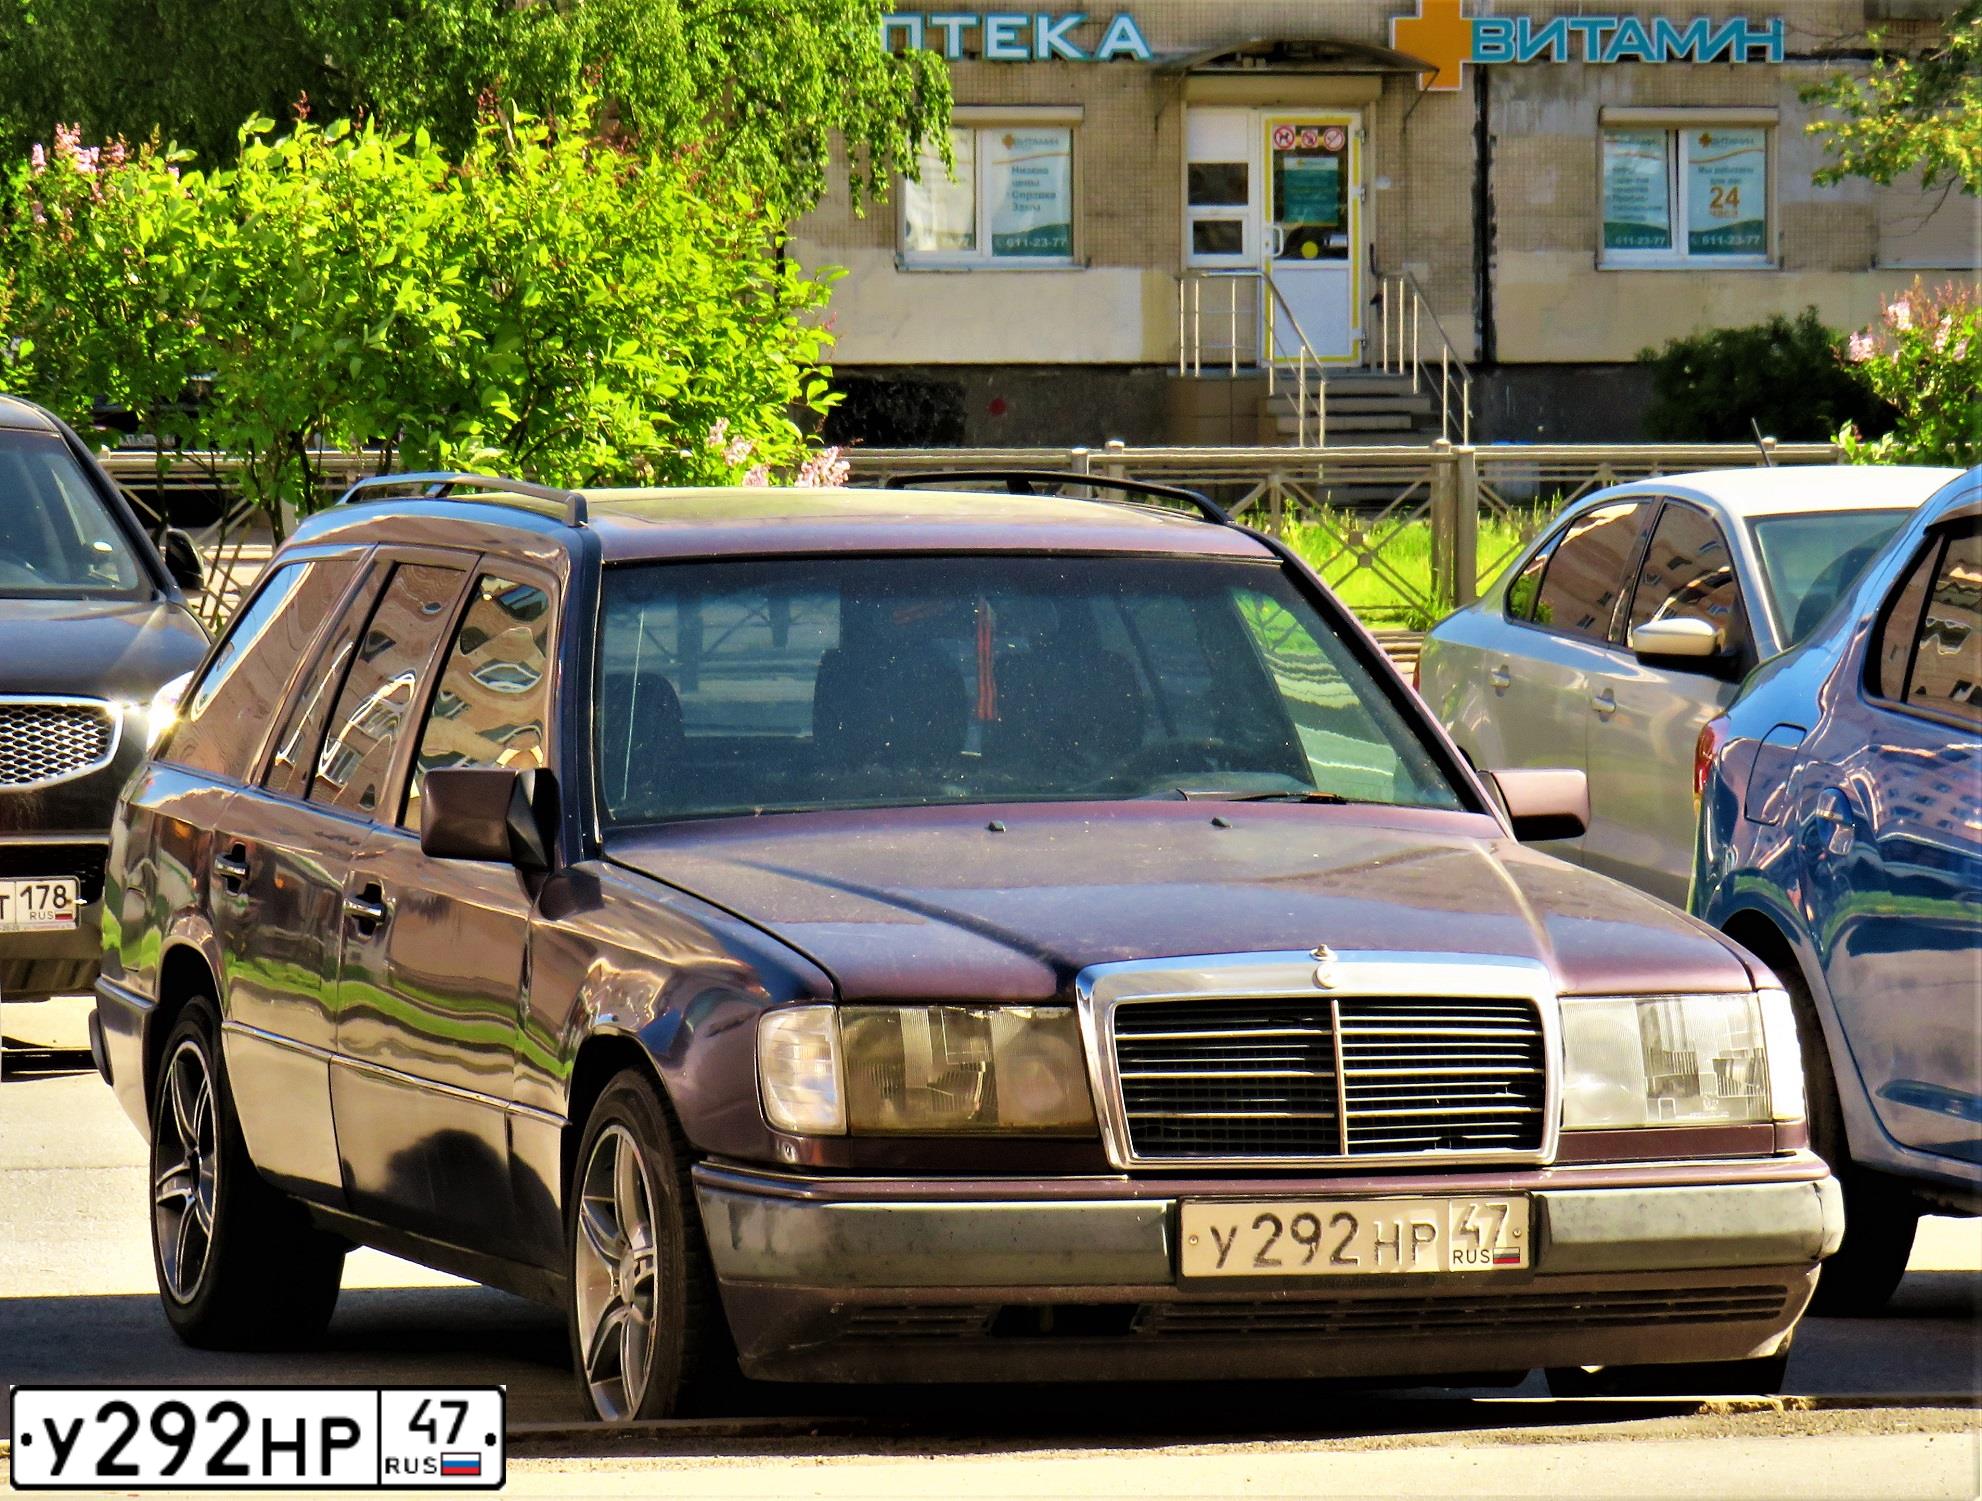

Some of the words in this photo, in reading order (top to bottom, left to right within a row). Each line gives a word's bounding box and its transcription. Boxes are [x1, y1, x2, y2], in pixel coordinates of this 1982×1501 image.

[877, 12, 1153, 62] ПТЕКА
[1470, 16, 1785, 64] ВИТАМИН
[1709, 185, 1741, 210] 24
[20, 884, 67, 910] 178
[30, 911, 54, 920] RUS
[1457, 1202, 1510, 1248] 47
[1452, 1249, 1490, 1264] RUS
